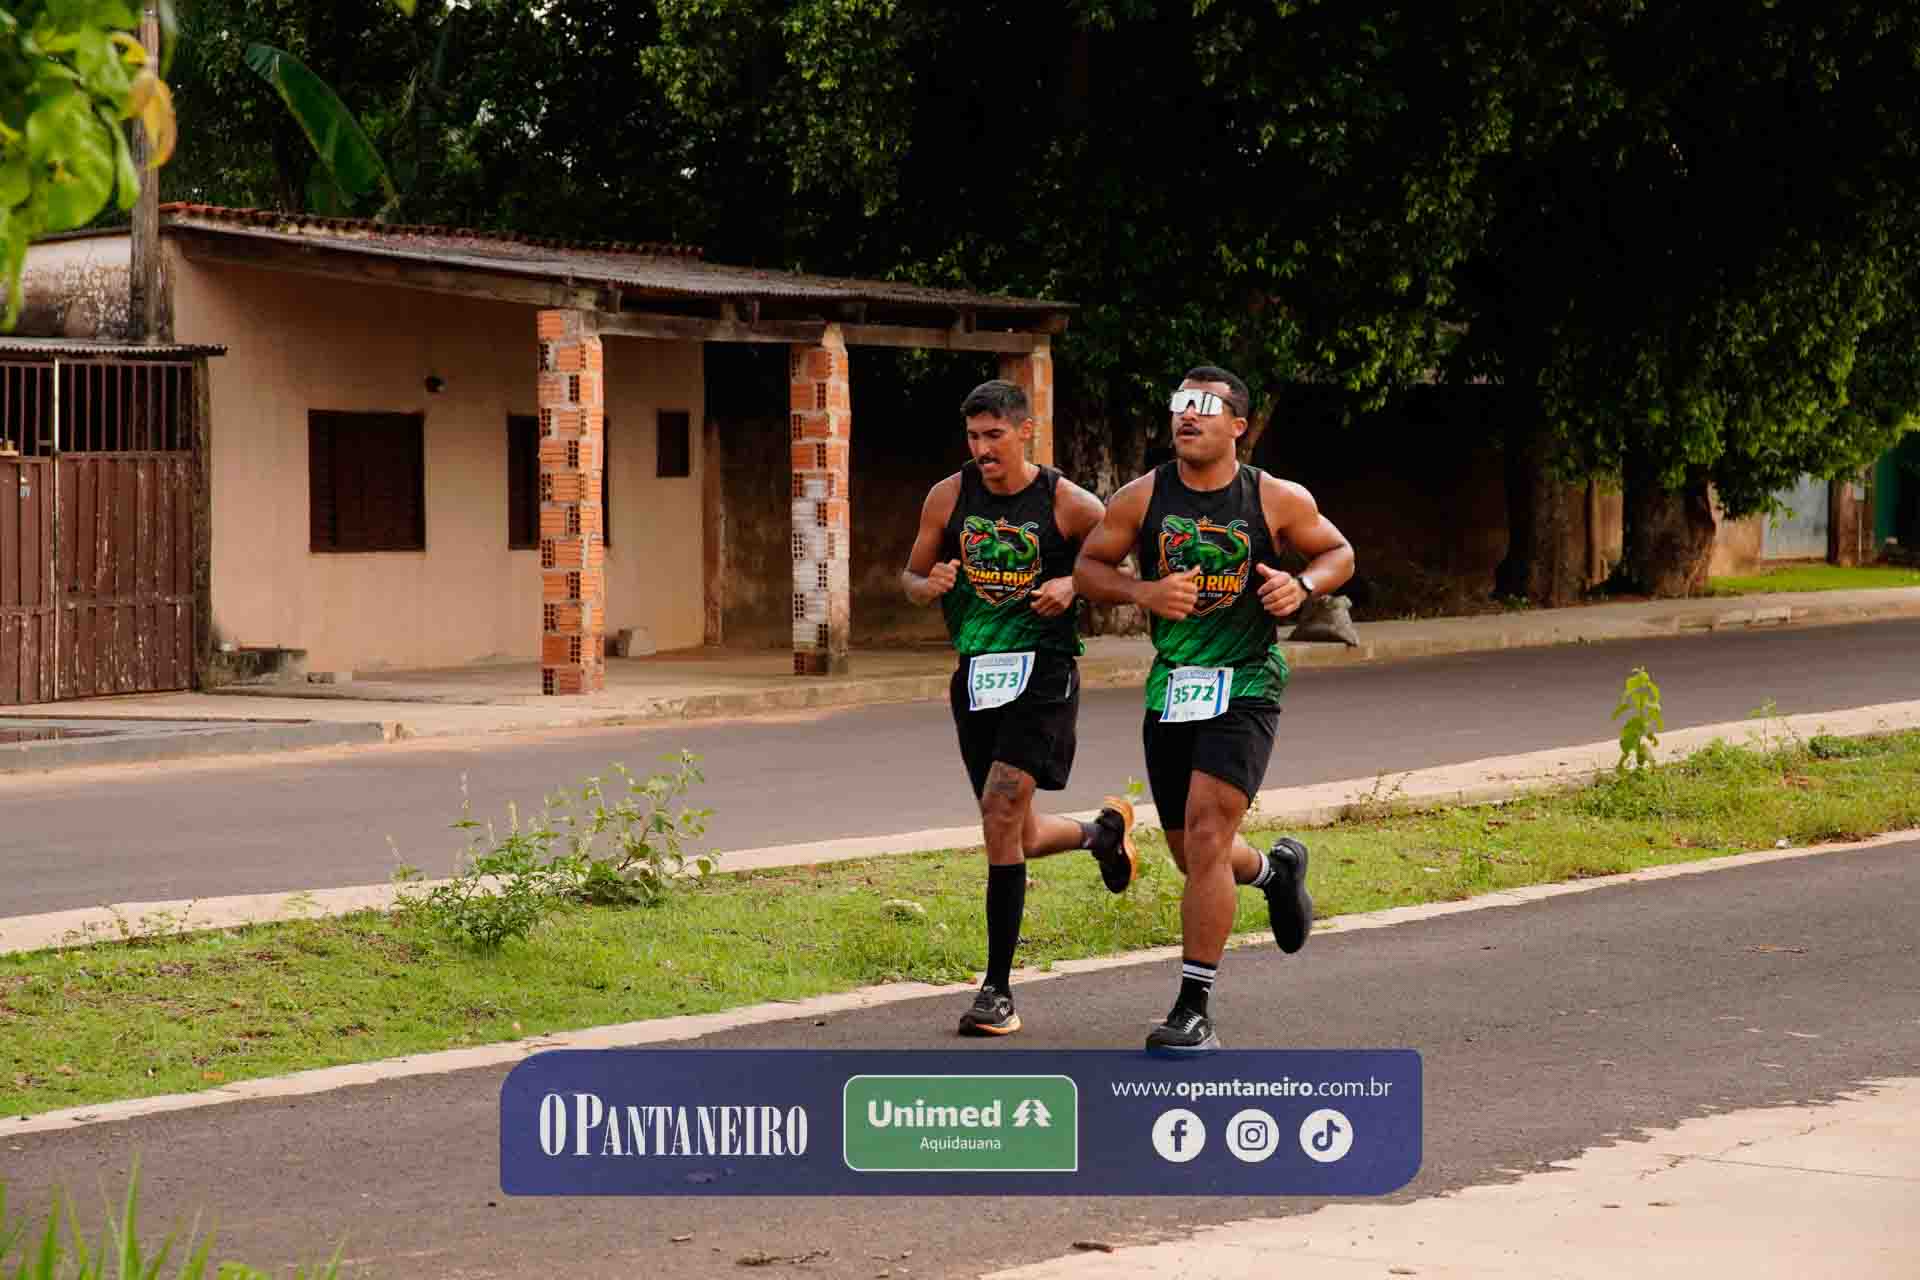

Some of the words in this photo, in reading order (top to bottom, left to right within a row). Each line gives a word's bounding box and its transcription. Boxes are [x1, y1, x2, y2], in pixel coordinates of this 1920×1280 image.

[1002, 571, 1034, 586] RUN
[1206, 575, 1241, 592] RUN
[975, 672, 1019, 690] 3573
[1173, 685, 1215, 704] 3572
